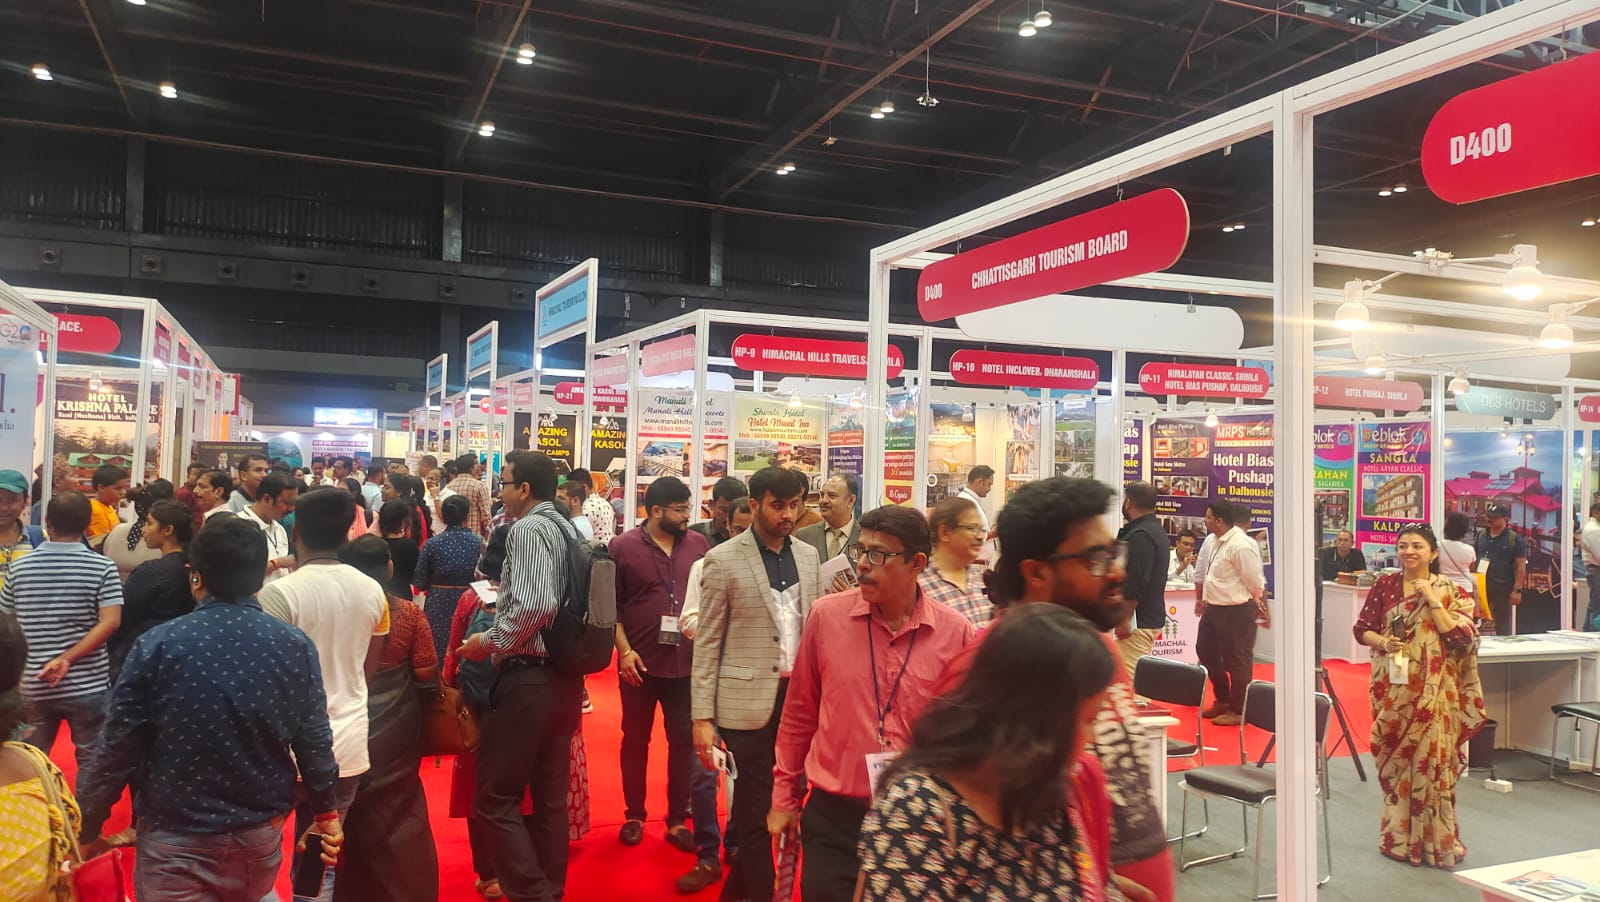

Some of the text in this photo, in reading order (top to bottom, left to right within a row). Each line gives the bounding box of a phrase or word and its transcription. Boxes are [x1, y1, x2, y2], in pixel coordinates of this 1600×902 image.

[1450, 122, 1512, 165] D400
[925, 229, 1128, 302] D400 CHHATTISGARH TOURISM BOARD
[735, 346, 756, 358] HP-9
[762, 348, 806, 361] HIMACHAL
[807, 351, 831, 363] HILLS
[952, 361, 975, 372] HP-10
[982, 363, 1005, 374] HOTEL
[1044, 367, 1096, 380] DHARAMSHALA
[1168, 369, 1204, 379] HIMALAYAN
[1235, 372, 1259, 382] SHIMLA
[1141, 374, 1160, 383] HP-11
[1165, 380, 1184, 390] HOTEL
[1186, 381, 1201, 391] BIAS
[1230, 383, 1263, 393] DALHOUSIE
[1314, 386, 1329, 395] P-12
[1344, 388, 1361, 397] HOTEL
[88, 393, 127, 403] HOTEL
[655, 395, 687, 405] Manali
[1481, 394, 1547, 413] DLS HOTELS
[57, 400, 111, 413] KRISHNA
[783, 408, 805, 418] Hotel
[747, 416, 769, 428] Hotel
[522, 426, 568, 436] AAZING
[1216, 425, 1245, 438] MRPS
[1363, 427, 1406, 443] Deblok
[1213, 453, 1274, 467] Hotel Bias
[1370, 453, 1417, 463] SANGLA
[1400, 465, 1424, 473] CLASSIC
[1228, 469, 1274, 486] Pushap
[1217, 485, 1274, 497] in Dalhousie
[1370, 534, 1387, 542] HOTEL
